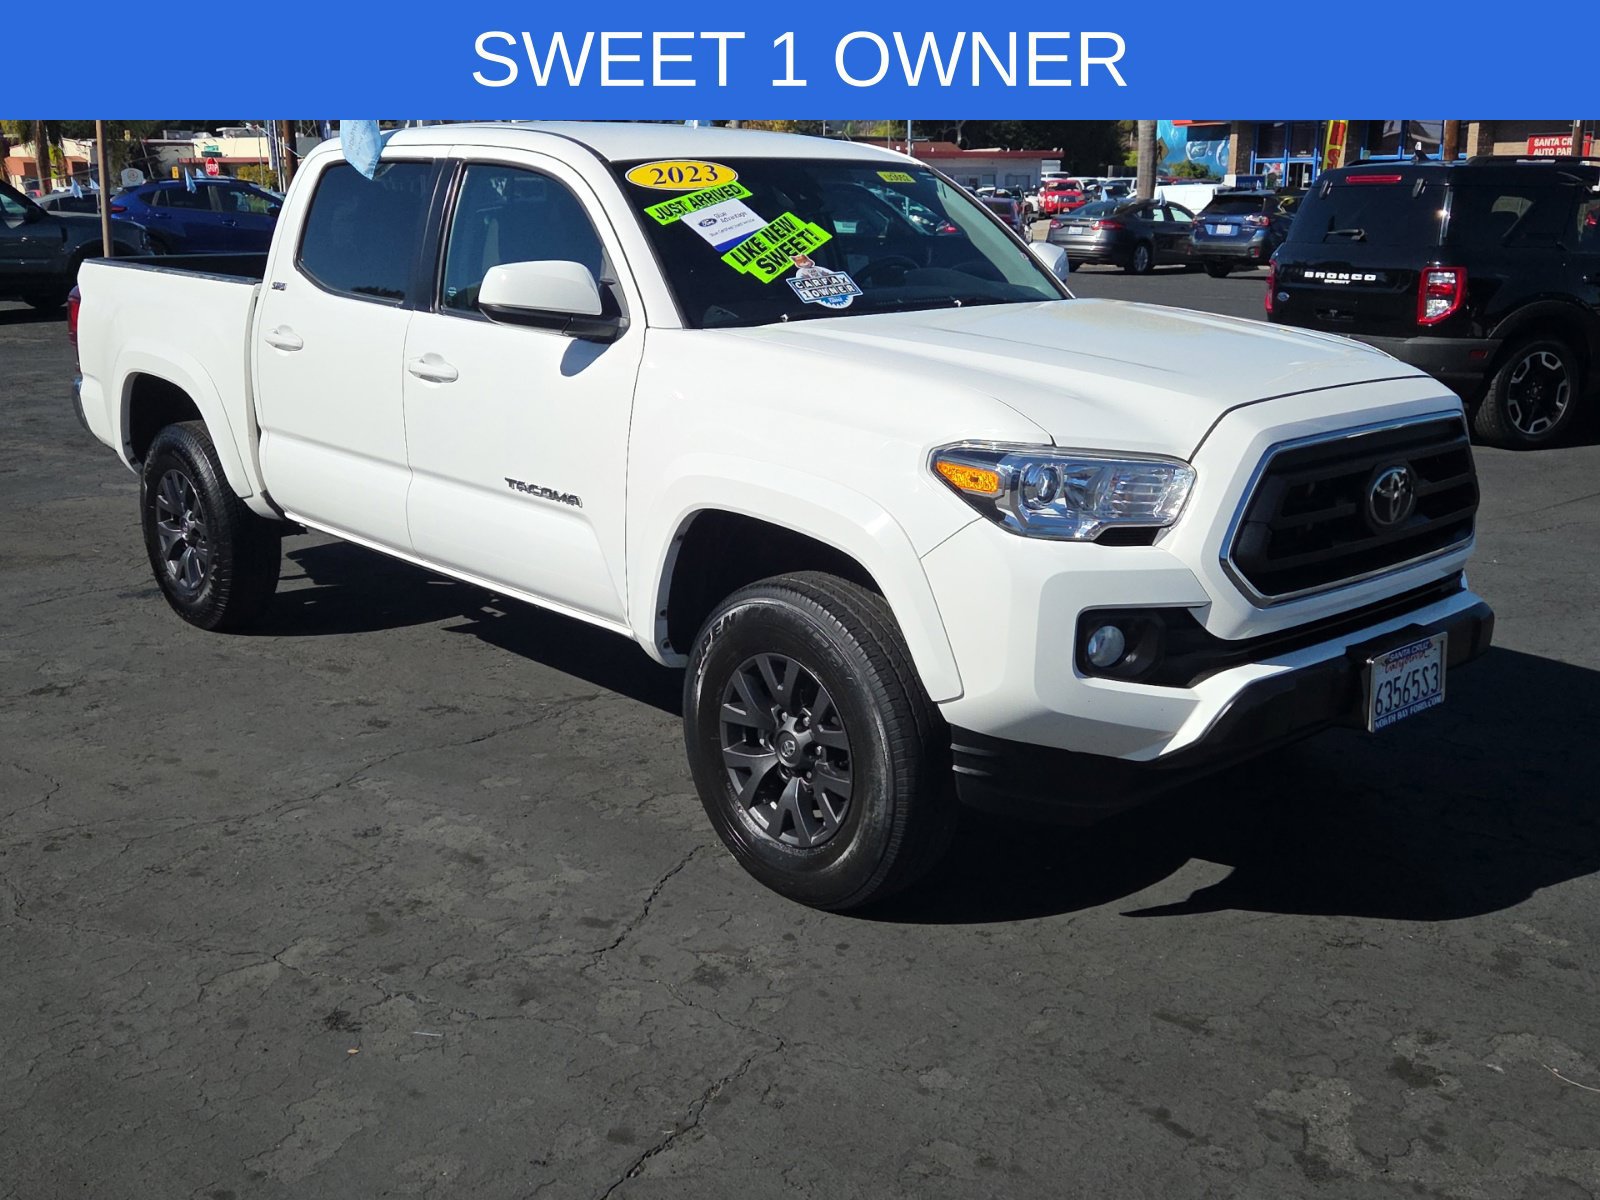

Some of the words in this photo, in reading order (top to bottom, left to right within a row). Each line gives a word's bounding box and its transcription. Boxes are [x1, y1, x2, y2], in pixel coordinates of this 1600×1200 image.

[1534, 137, 1560, 147] SANTA
[1561, 137, 1573, 146] CR
[1533, 147, 1555, 156] AUTO
[1556, 147, 1572, 156] PAR
[206, 163, 219, 173] STOP
[649, 165, 718, 185] 2023
[654, 200, 688, 220] JUST
[687, 184, 744, 209] ARRIVED
[730, 236, 769, 267] LIKE
[760, 216, 797, 245] NEW
[756, 228, 822, 275] SWEET!
[795, 276, 848, 289] CARFAX
[1304, 271, 1377, 281] BRONCO
[812, 284, 856, 298] OWNER
[504, 477, 583, 509] TACOMA
[1374, 662, 1439, 716] 63565S3
